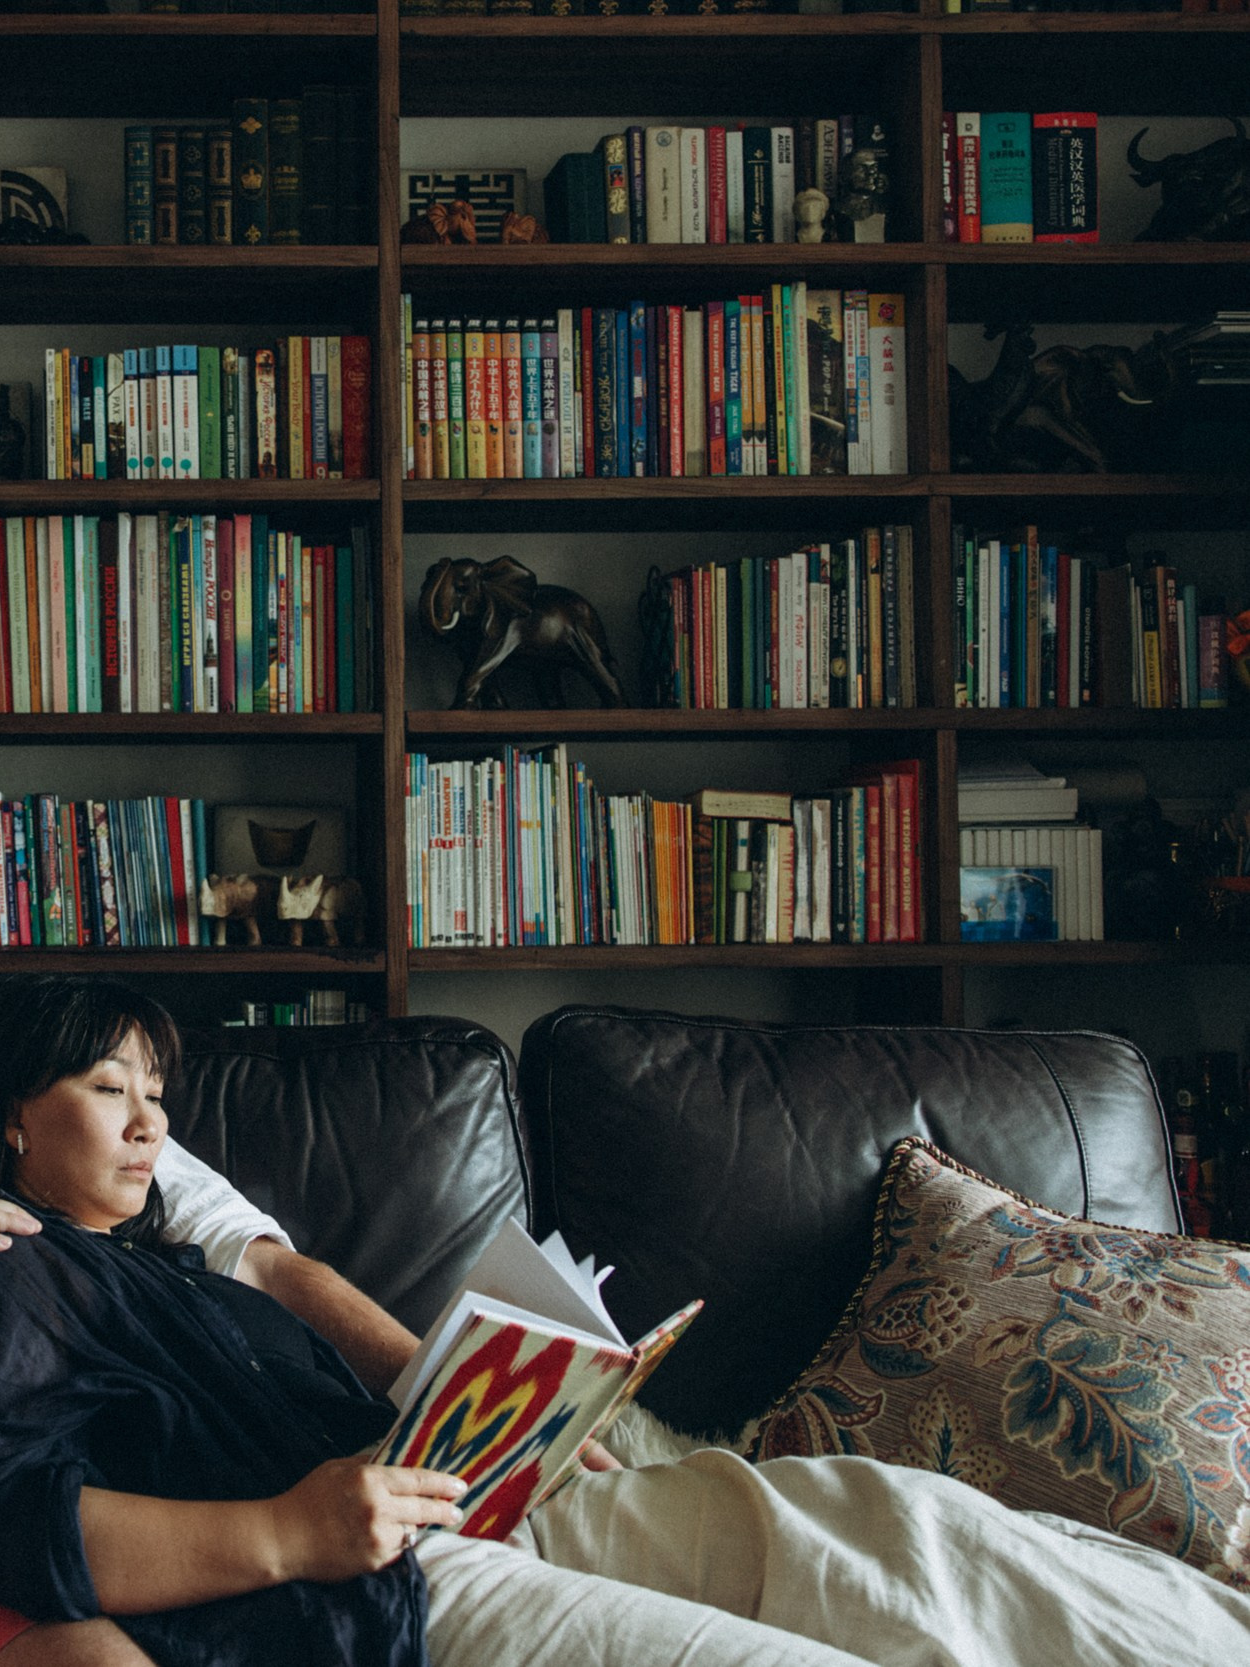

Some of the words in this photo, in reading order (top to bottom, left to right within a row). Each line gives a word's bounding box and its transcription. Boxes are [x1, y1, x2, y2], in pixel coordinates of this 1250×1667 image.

[691, 135, 699, 166] ЛЮБИТЬ
[824, 125, 835, 153] ДЭН
[715, 131, 724, 200] МАРИНИНА
[692, 167, 700, 209] МОЛИТЬСЯ,
[730, 370, 739, 393] TIGER
[112, 396, 121, 415] PAX
[104, 566, 117, 616] РОССИИ
[181, 563, 190, 620] СКАЗКАМИ
[205, 579, 217, 621] РОССИИ
[956, 576, 966, 607] ВИНО
[104, 619, 118, 677] ИСТОРИЯ
[181, 623, 190, 636] СО
[181, 639, 191, 667] ИГРЫ
[443, 777, 452, 837] ТЕХНОЛОГИЯ
[902, 808, 911, 852] МОСКВА
[902, 866, 912, 913] MOSCOW
